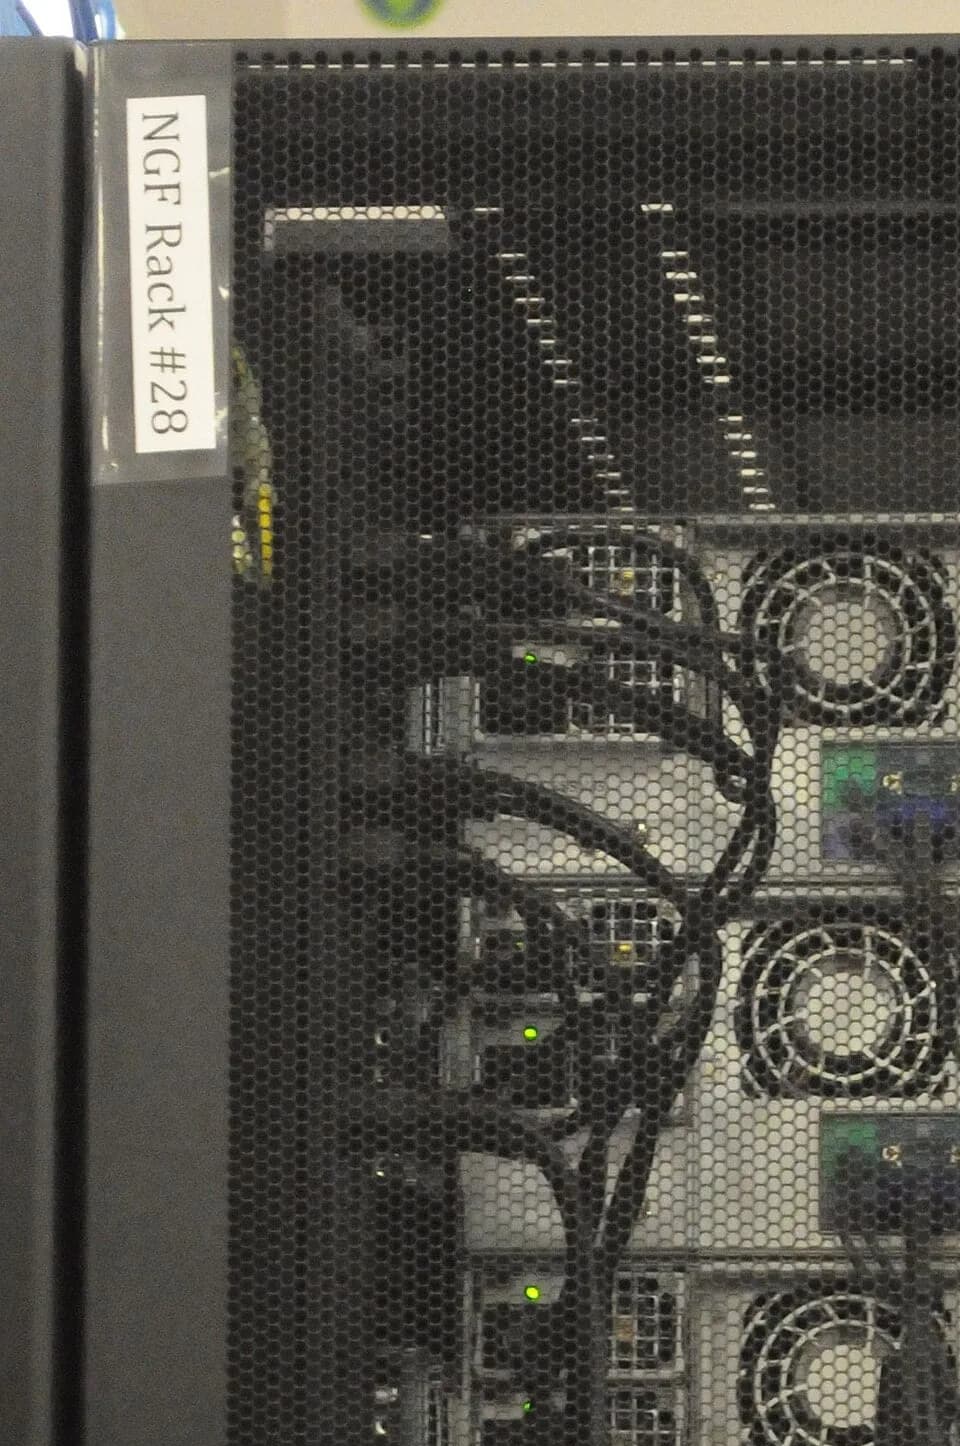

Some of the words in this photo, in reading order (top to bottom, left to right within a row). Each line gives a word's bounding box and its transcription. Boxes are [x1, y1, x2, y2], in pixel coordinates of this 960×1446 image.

[141, 112, 182, 206] NGF
[144, 223, 187, 331] Rack
[149, 346, 189, 435] #28
